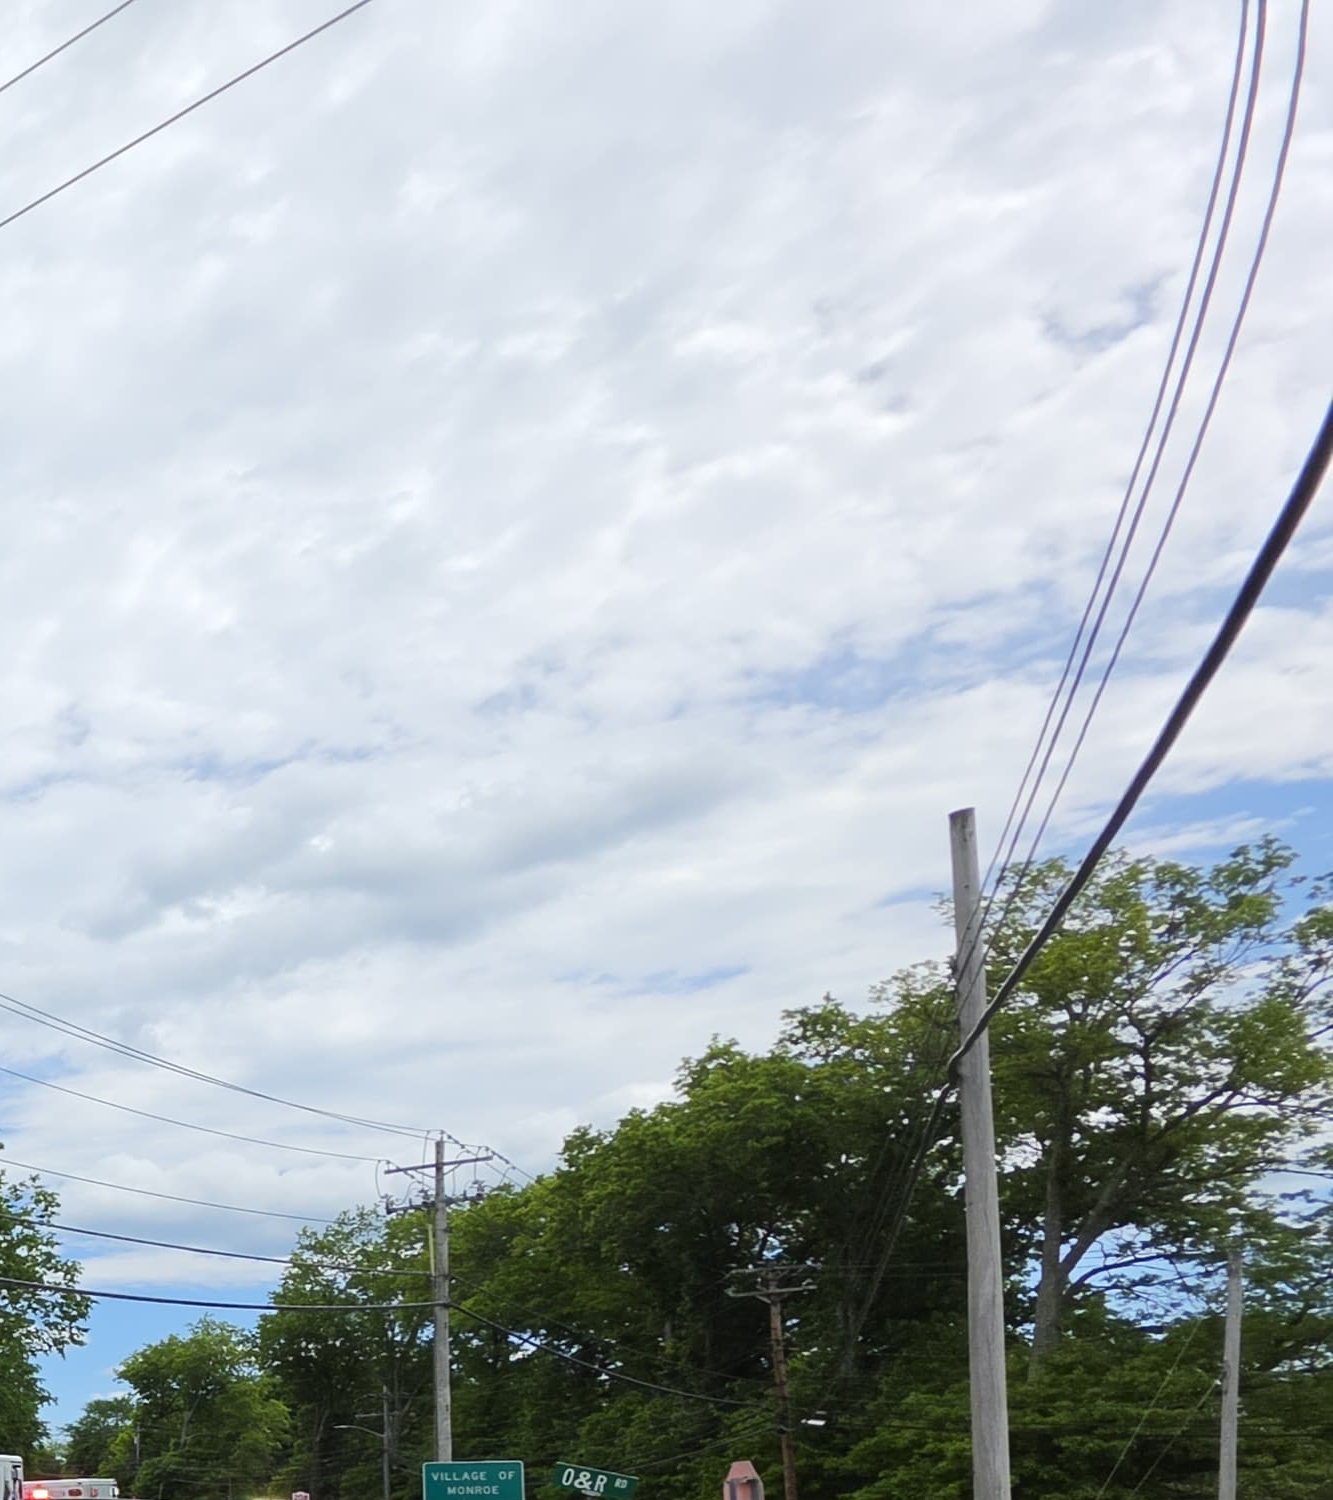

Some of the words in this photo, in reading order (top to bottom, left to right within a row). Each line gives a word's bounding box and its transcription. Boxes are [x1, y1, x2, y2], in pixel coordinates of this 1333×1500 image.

[431, 1471, 487, 1481] VILLAGE
[498, 1471, 515, 1480] OF
[562, 1467, 607, 1492] O&R
[614, 1478, 627, 1488] RD
[447, 1485, 500, 1495] MONROE
